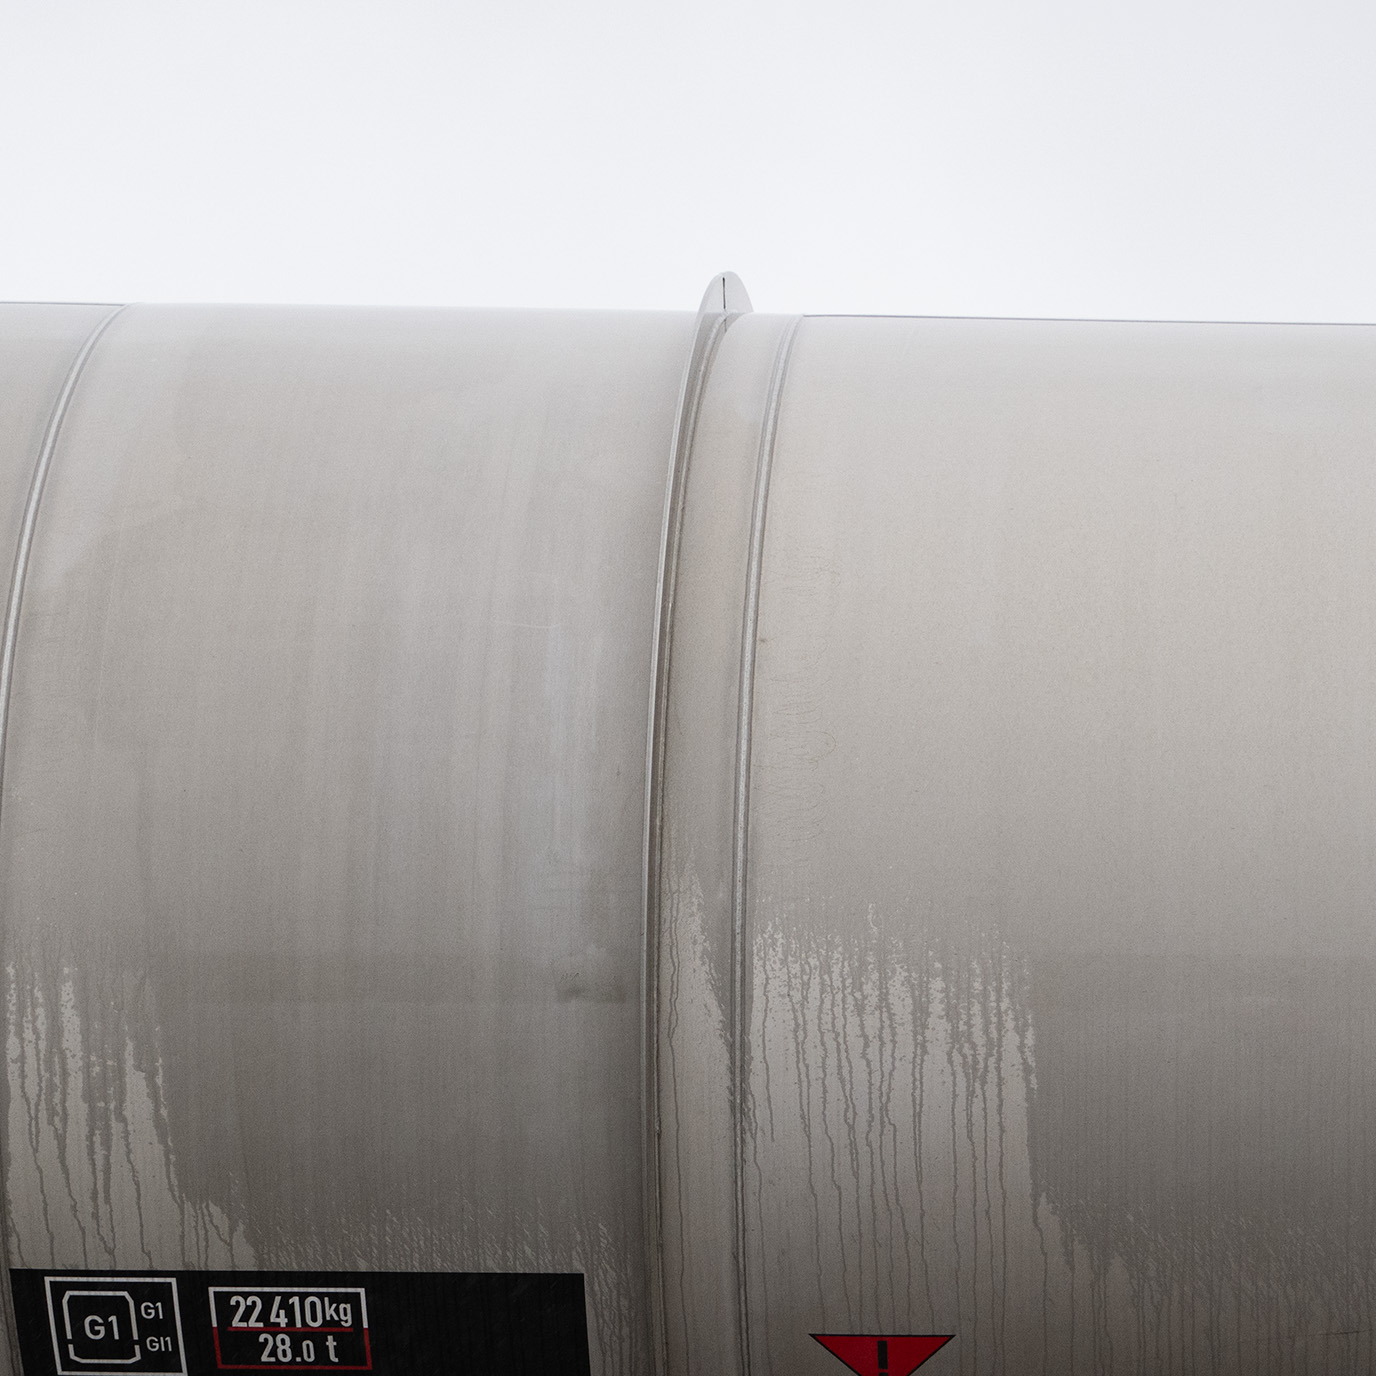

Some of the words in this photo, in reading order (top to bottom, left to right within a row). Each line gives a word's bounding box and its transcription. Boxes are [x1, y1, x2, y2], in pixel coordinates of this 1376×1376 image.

[140, 1301, 164, 1320] G1
[84, 1315, 120, 1340] G1
[258, 1333, 315, 1363] 28.0
[325, 1335, 339, 1363] t
